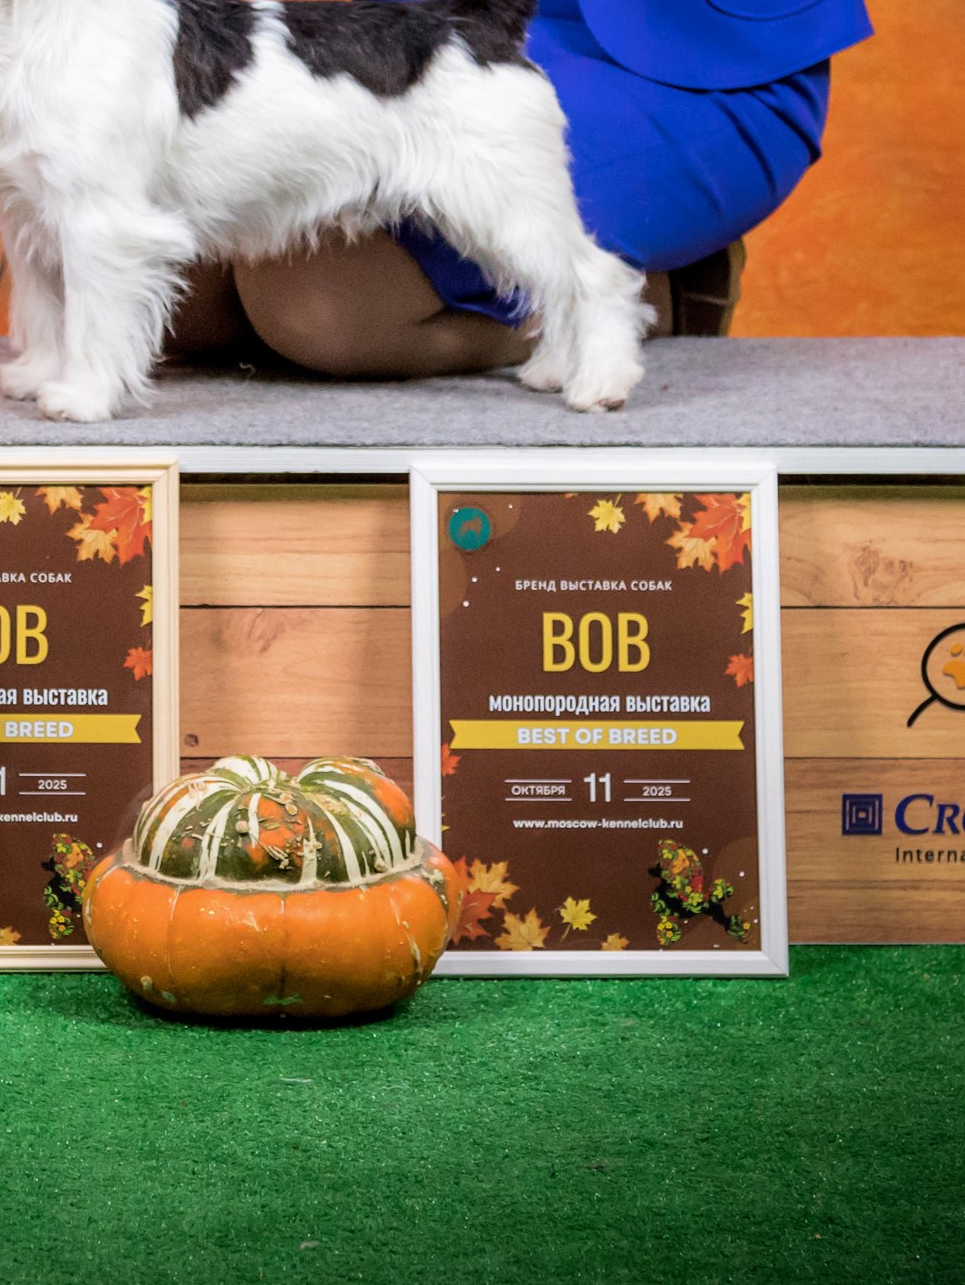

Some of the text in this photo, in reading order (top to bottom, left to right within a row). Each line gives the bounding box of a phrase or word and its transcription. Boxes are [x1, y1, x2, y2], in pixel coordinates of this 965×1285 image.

[29, 572, 72, 583] СОБАК
[514, 579, 673, 593] БРЕНД ВЫСТАВКА СОБАК
[541, 611, 651, 673] BOB
[22, 688, 108, 706] выставка
[489, 694, 711, 717] монопородная выставка
[4, 720, 75, 738] BREED
[516, 727, 678, 745] BEST OF BREED
[37, 779, 68, 790] 2025
[511, 772, 672, 803] ОКТЯБРЯ 11 2025
[895, 794, 965, 834] CR
[512, 818, 684, 830] www.moscow-kennelclub.ru
